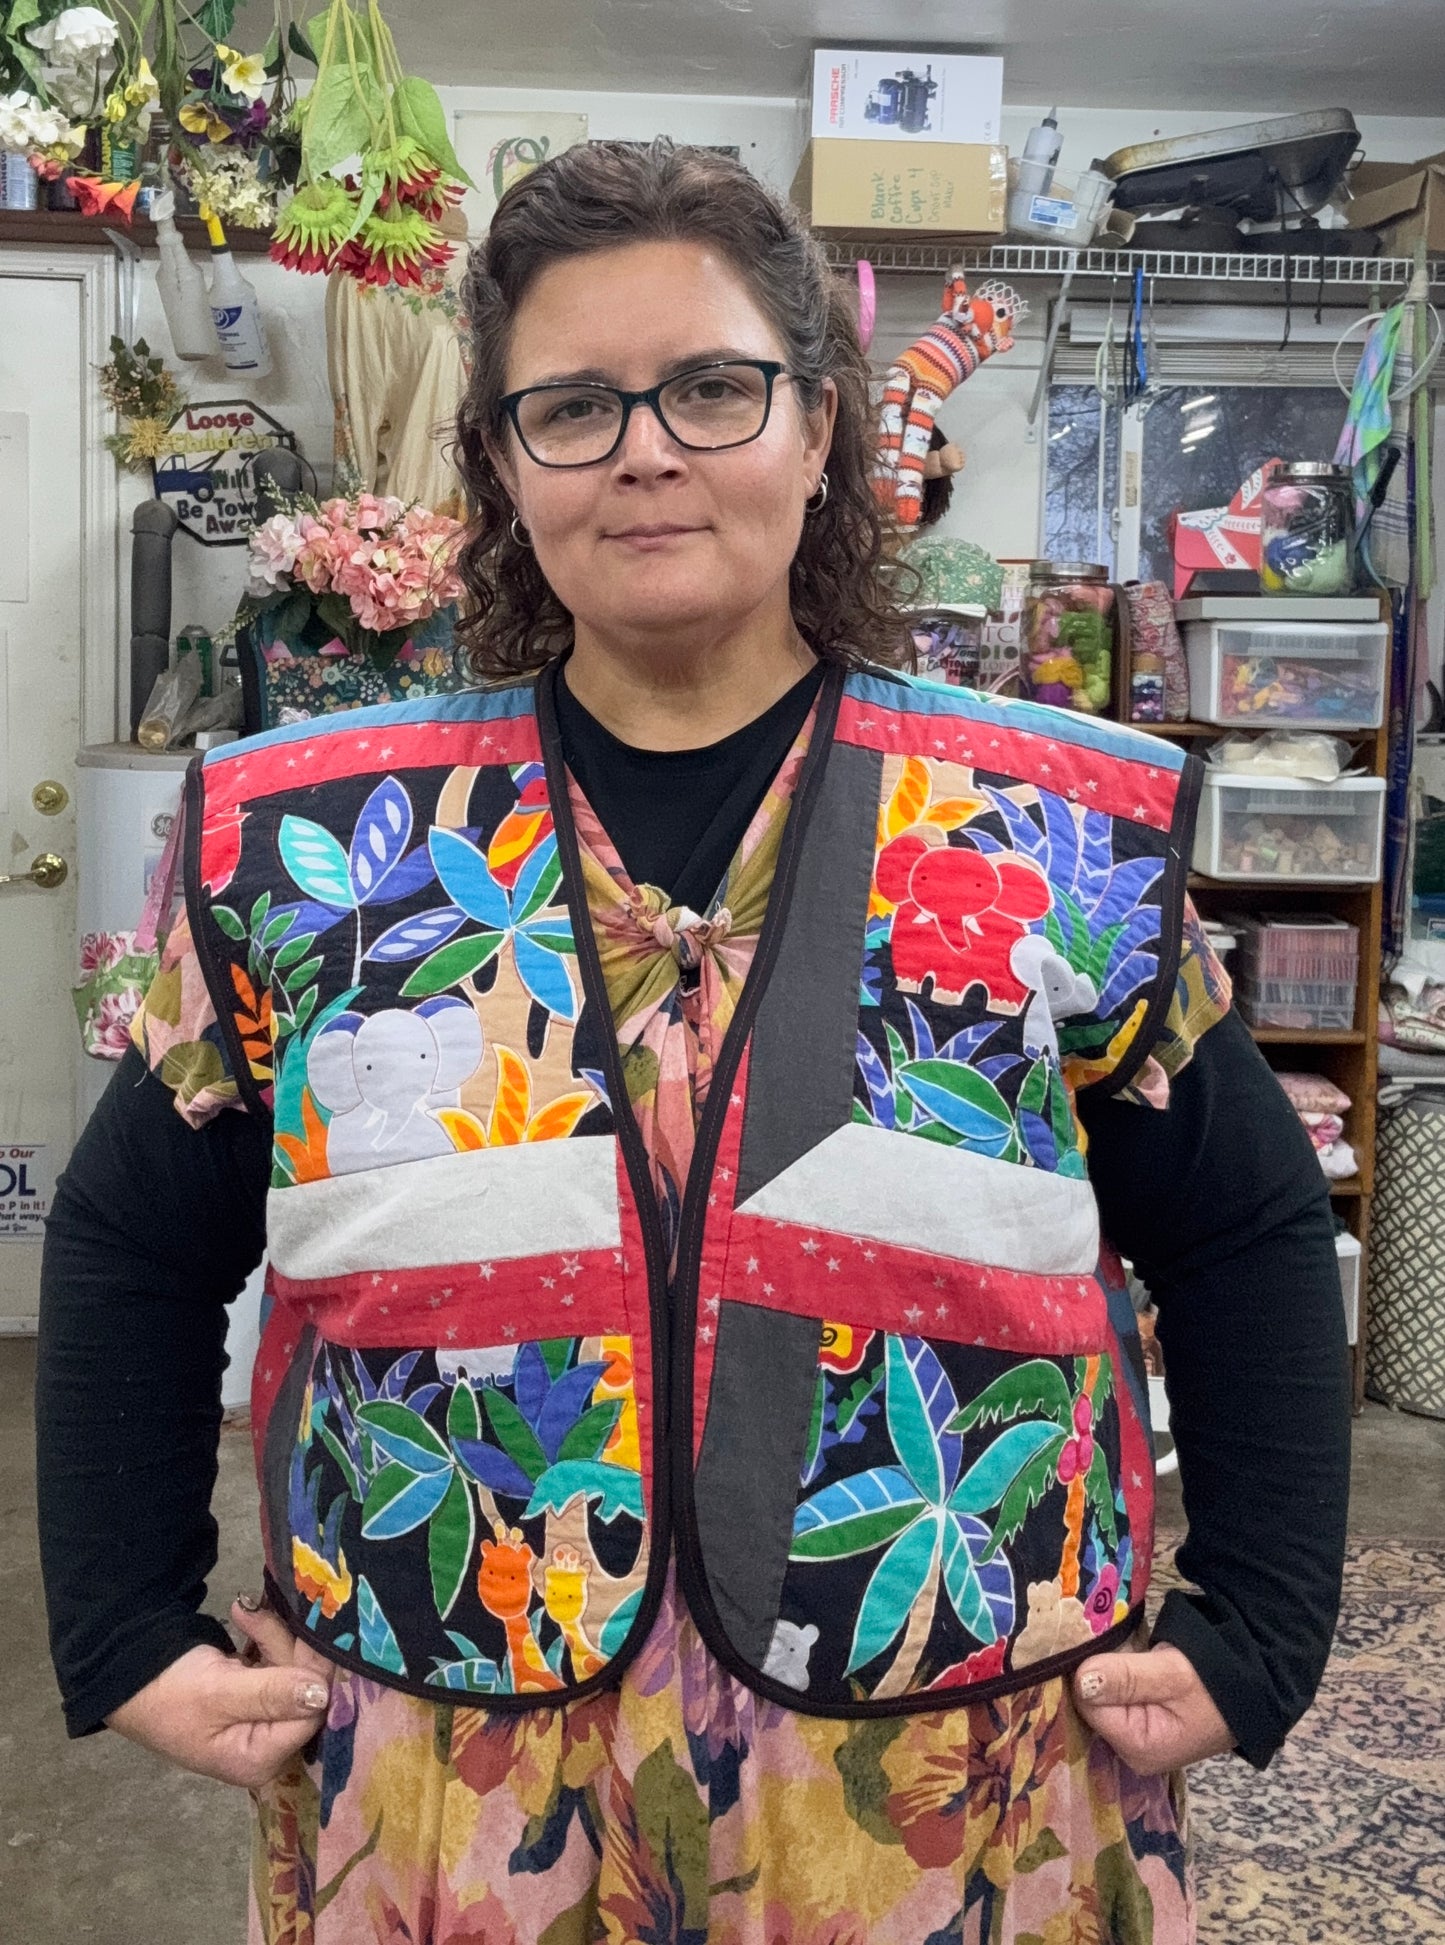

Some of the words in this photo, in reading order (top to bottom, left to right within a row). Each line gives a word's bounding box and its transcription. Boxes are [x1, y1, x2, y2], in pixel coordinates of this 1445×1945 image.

[870, 169, 886, 219] Blank
[186, 409, 255, 430] Loose
[171, 430, 274, 451] Children
[211, 468, 249, 489] Will
[176, 499, 203, 520] Be
[9, 1148, 35, 1159] Our
[9, 1201, 17, 1210] P
[20, 1201, 30, 1210] in
